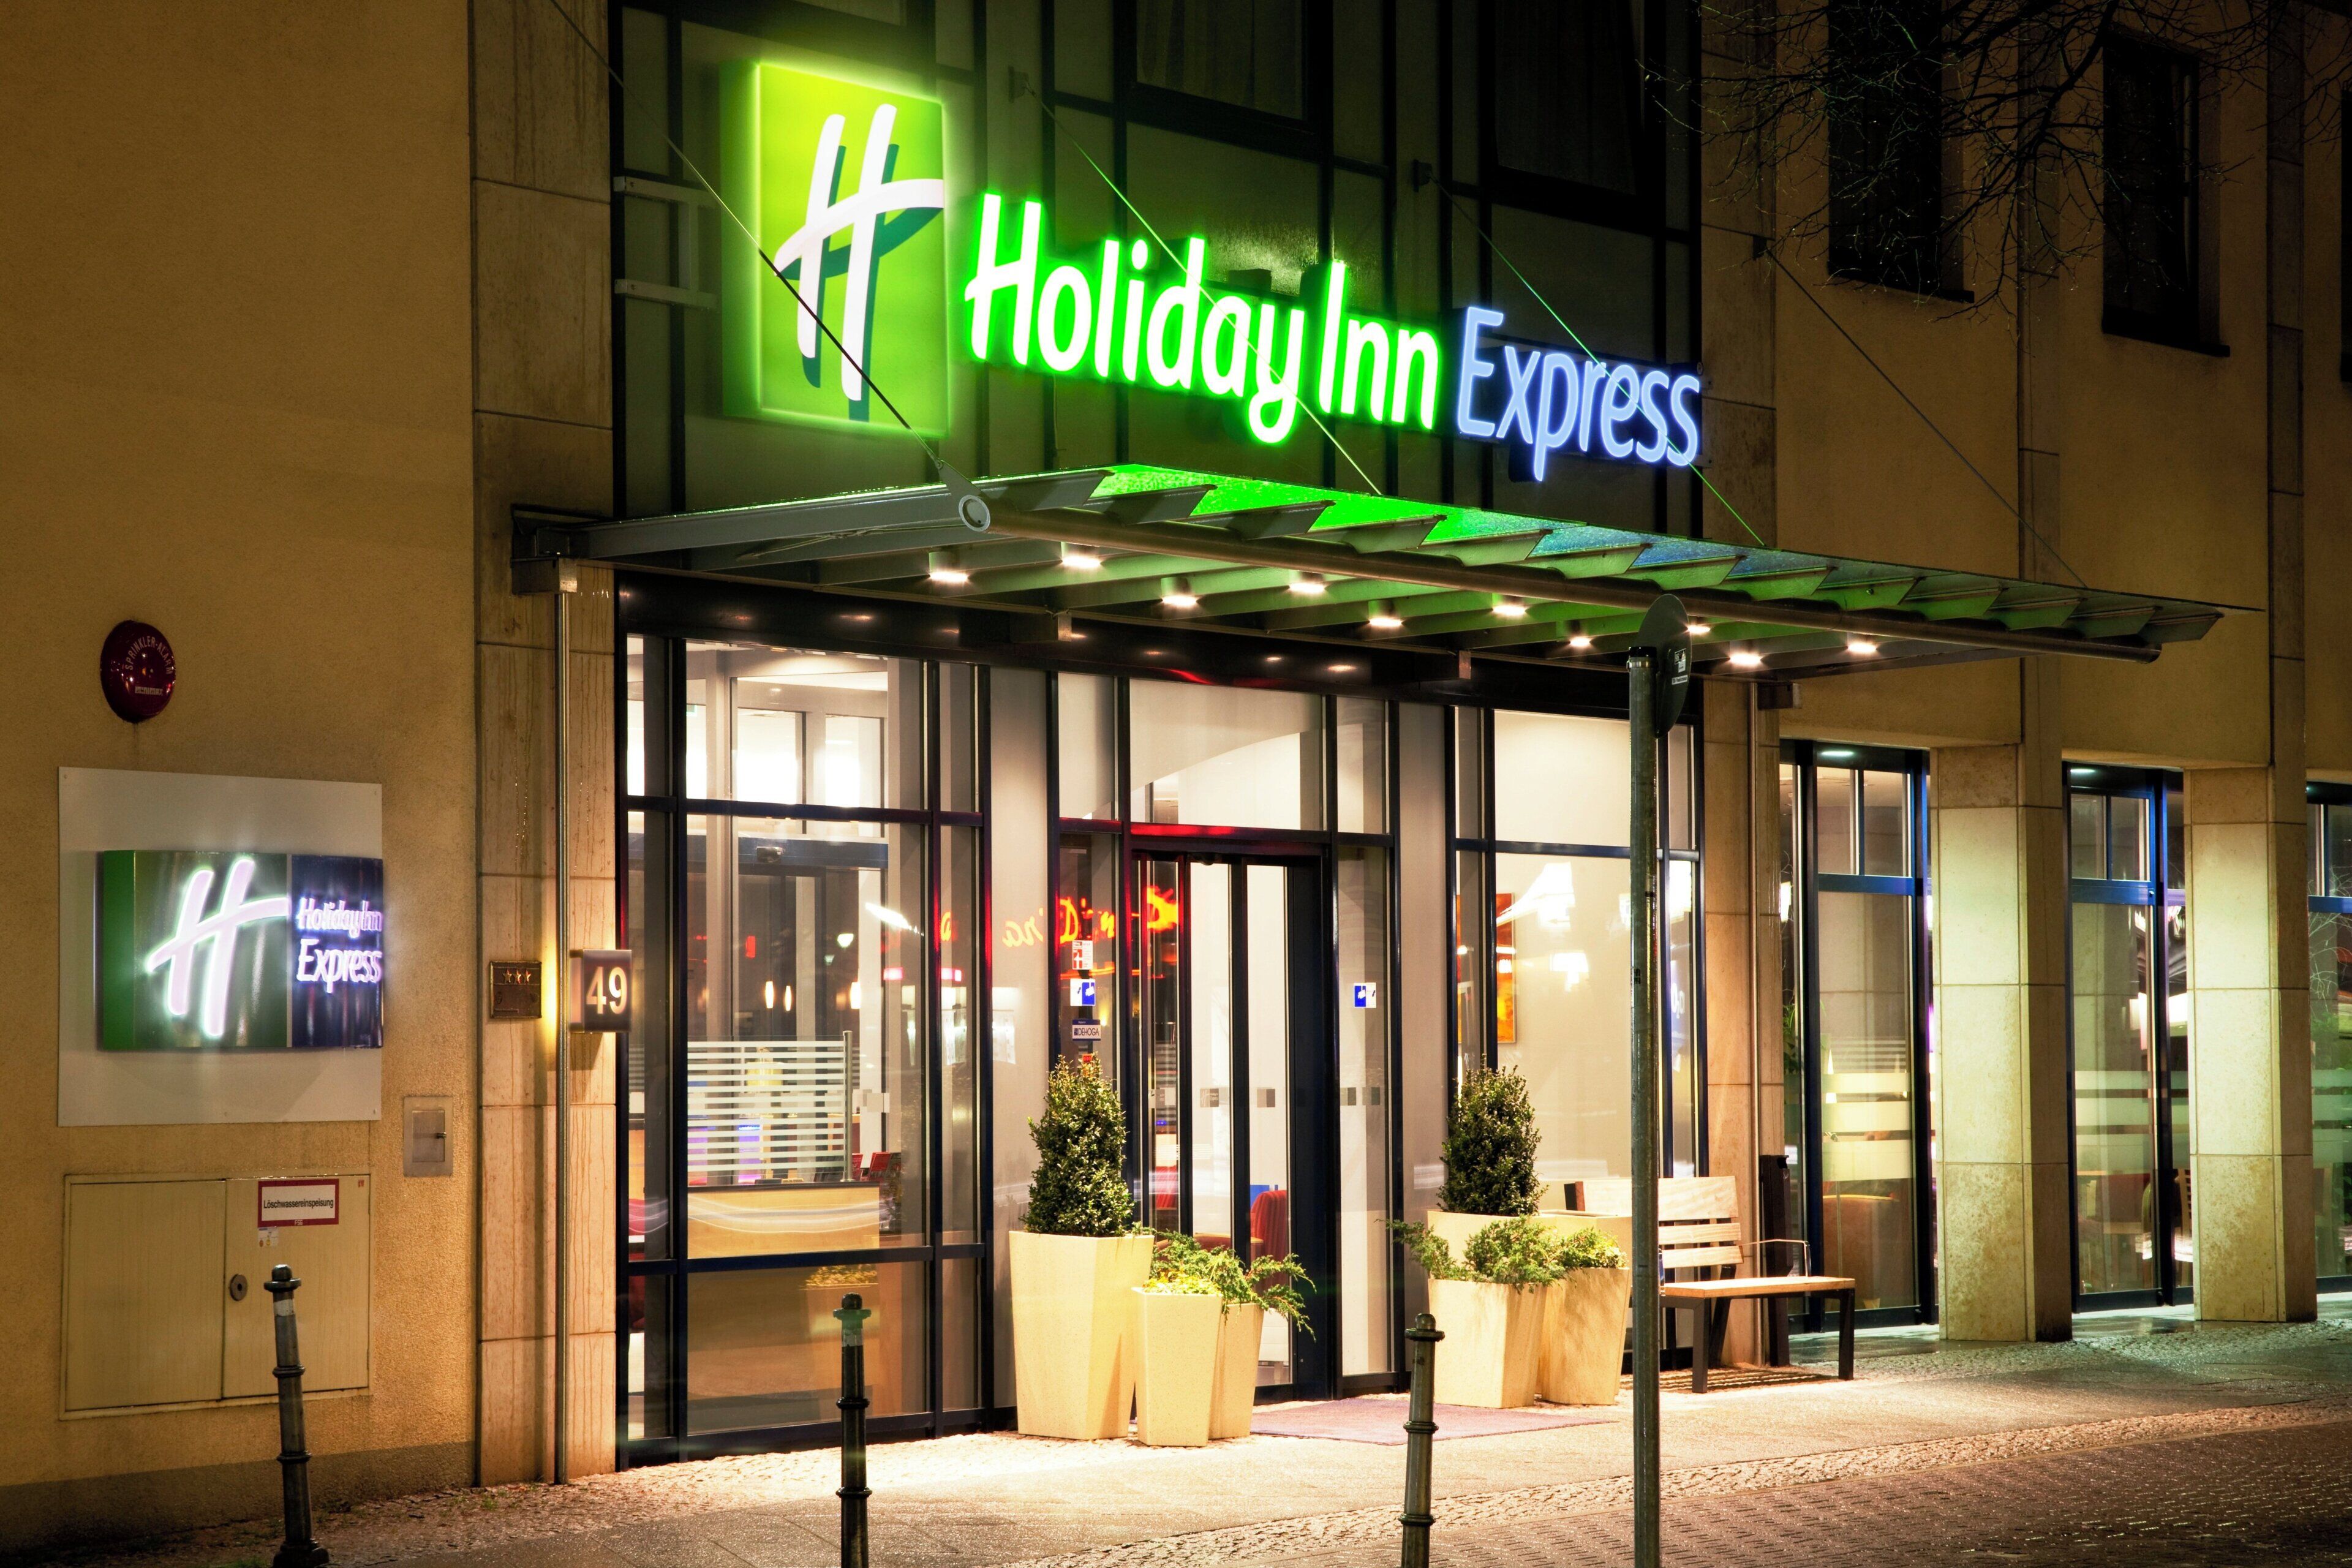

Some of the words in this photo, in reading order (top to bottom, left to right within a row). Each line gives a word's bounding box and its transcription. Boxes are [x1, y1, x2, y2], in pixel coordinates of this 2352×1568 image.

[965, 194, 1307, 444] Holiday
[1319, 260, 1440, 430] Inn
[1458, 307, 1702, 482] Express
[296, 897, 360, 938] Holiday
[296, 938, 383, 993] Express
[586, 966, 627, 1015] 49
[1078, 1027, 1099, 1036] DEHOGA
[263, 1198, 334, 1208] Löschwassereinspeisung
